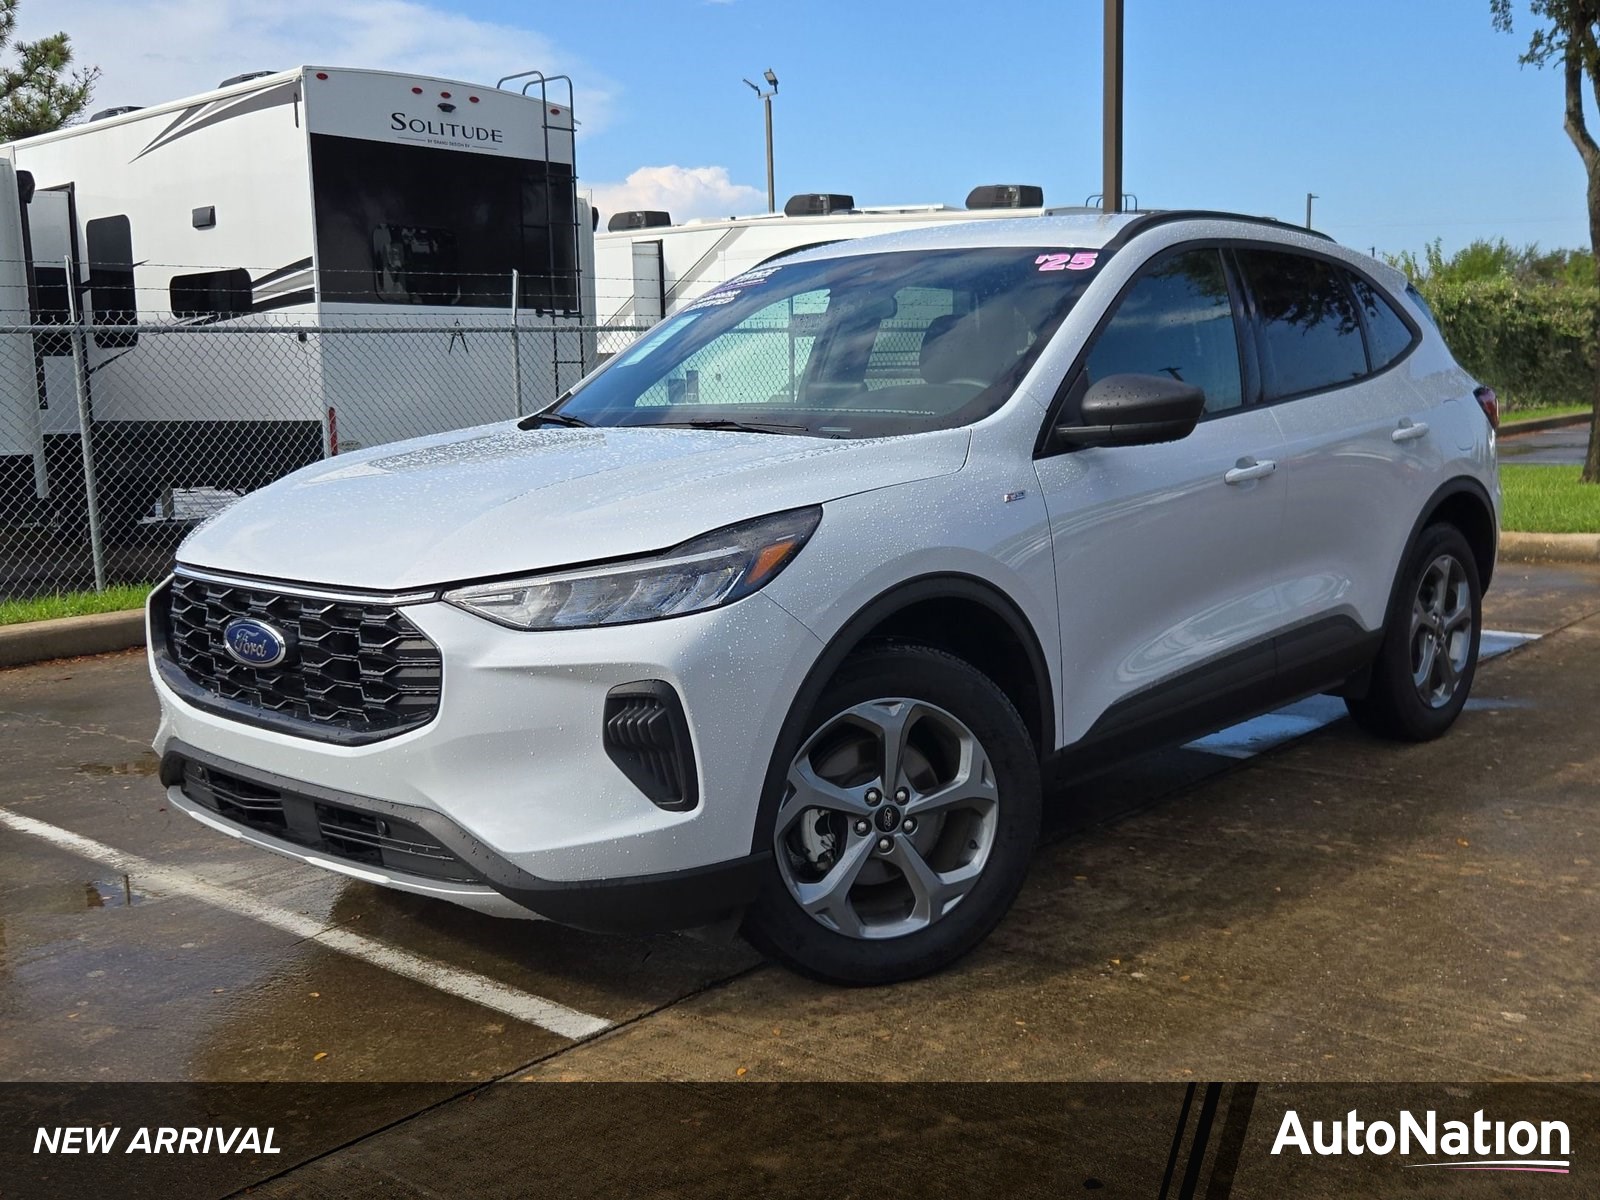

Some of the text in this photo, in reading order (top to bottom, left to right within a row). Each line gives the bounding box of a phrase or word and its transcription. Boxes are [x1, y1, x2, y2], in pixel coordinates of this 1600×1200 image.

[391, 112, 503, 143] SOLITUDE
[1035, 252, 1098, 271] '25
[234, 628, 267, 657] Ford
